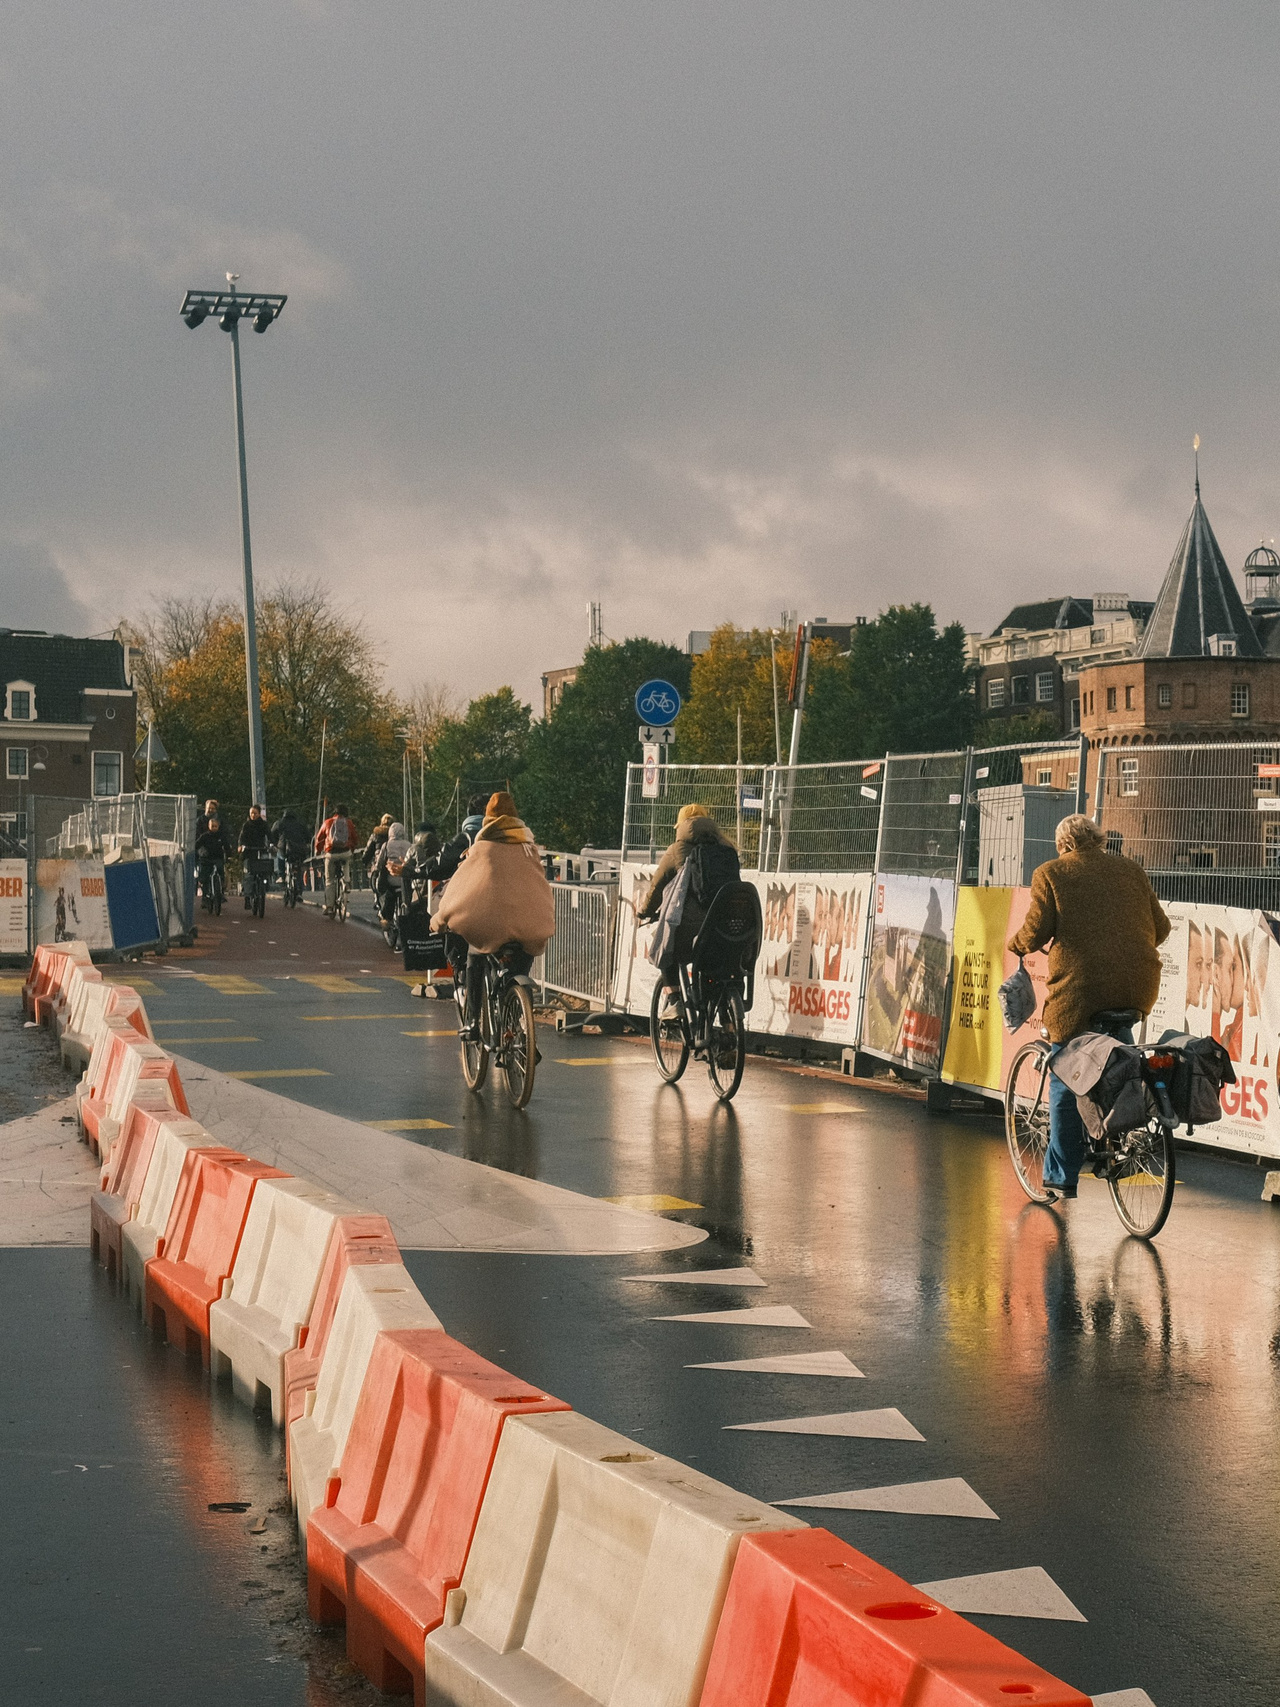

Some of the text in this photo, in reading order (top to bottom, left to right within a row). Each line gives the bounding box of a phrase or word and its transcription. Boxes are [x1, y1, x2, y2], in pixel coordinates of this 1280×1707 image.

[962, 972, 988, 990] CULTUUR
[788, 985, 850, 1021] PASSAGES
[960, 992, 990, 1010] RECLAME
[959, 1012, 974, 1028] HIER
